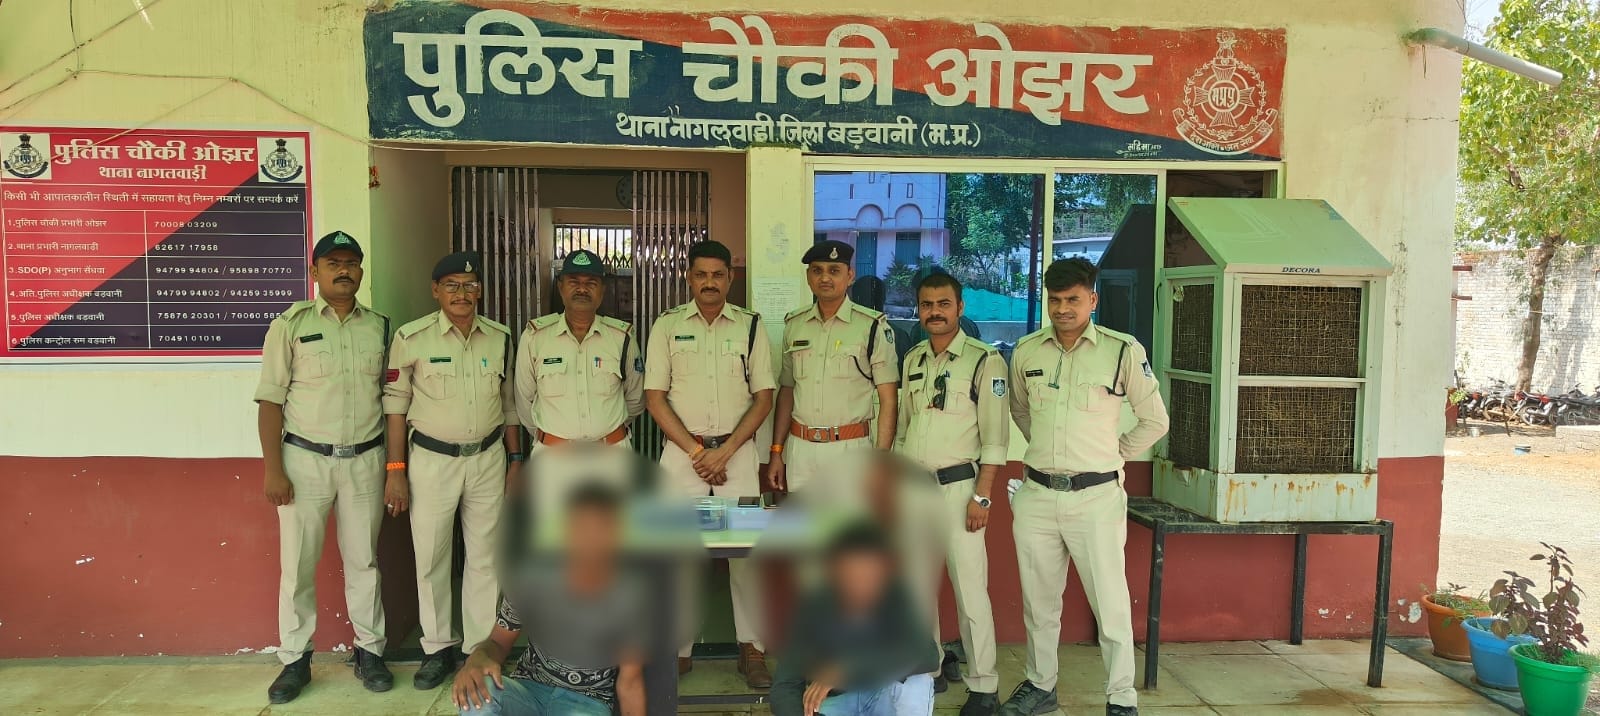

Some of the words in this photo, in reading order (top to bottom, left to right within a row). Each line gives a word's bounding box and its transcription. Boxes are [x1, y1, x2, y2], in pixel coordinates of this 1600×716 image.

[393, 9, 642, 128] पुलिस
[682, 15, 898, 106] चौकी
[925, 22, 1153, 126] ओझर
[616, 112, 670, 138] थाना
[827, 115, 918, 149] बड़वानी
[921, 121, 981, 148] (म.प्र.)
[125, 140, 186, 160] चौकी
[192, 141, 255, 164] ओझर
[99, 166, 132, 178] थाना
[4, 190, 27, 201] किसी
[30, 190, 40, 201] भी
[43, 191, 100, 202] आपातकालीन
[193, 192, 213, 203] निम्न
[244, 195, 255, 204] पर
[257, 194, 282, 204] सम्पर्क
[285, 194, 299, 204] करें
